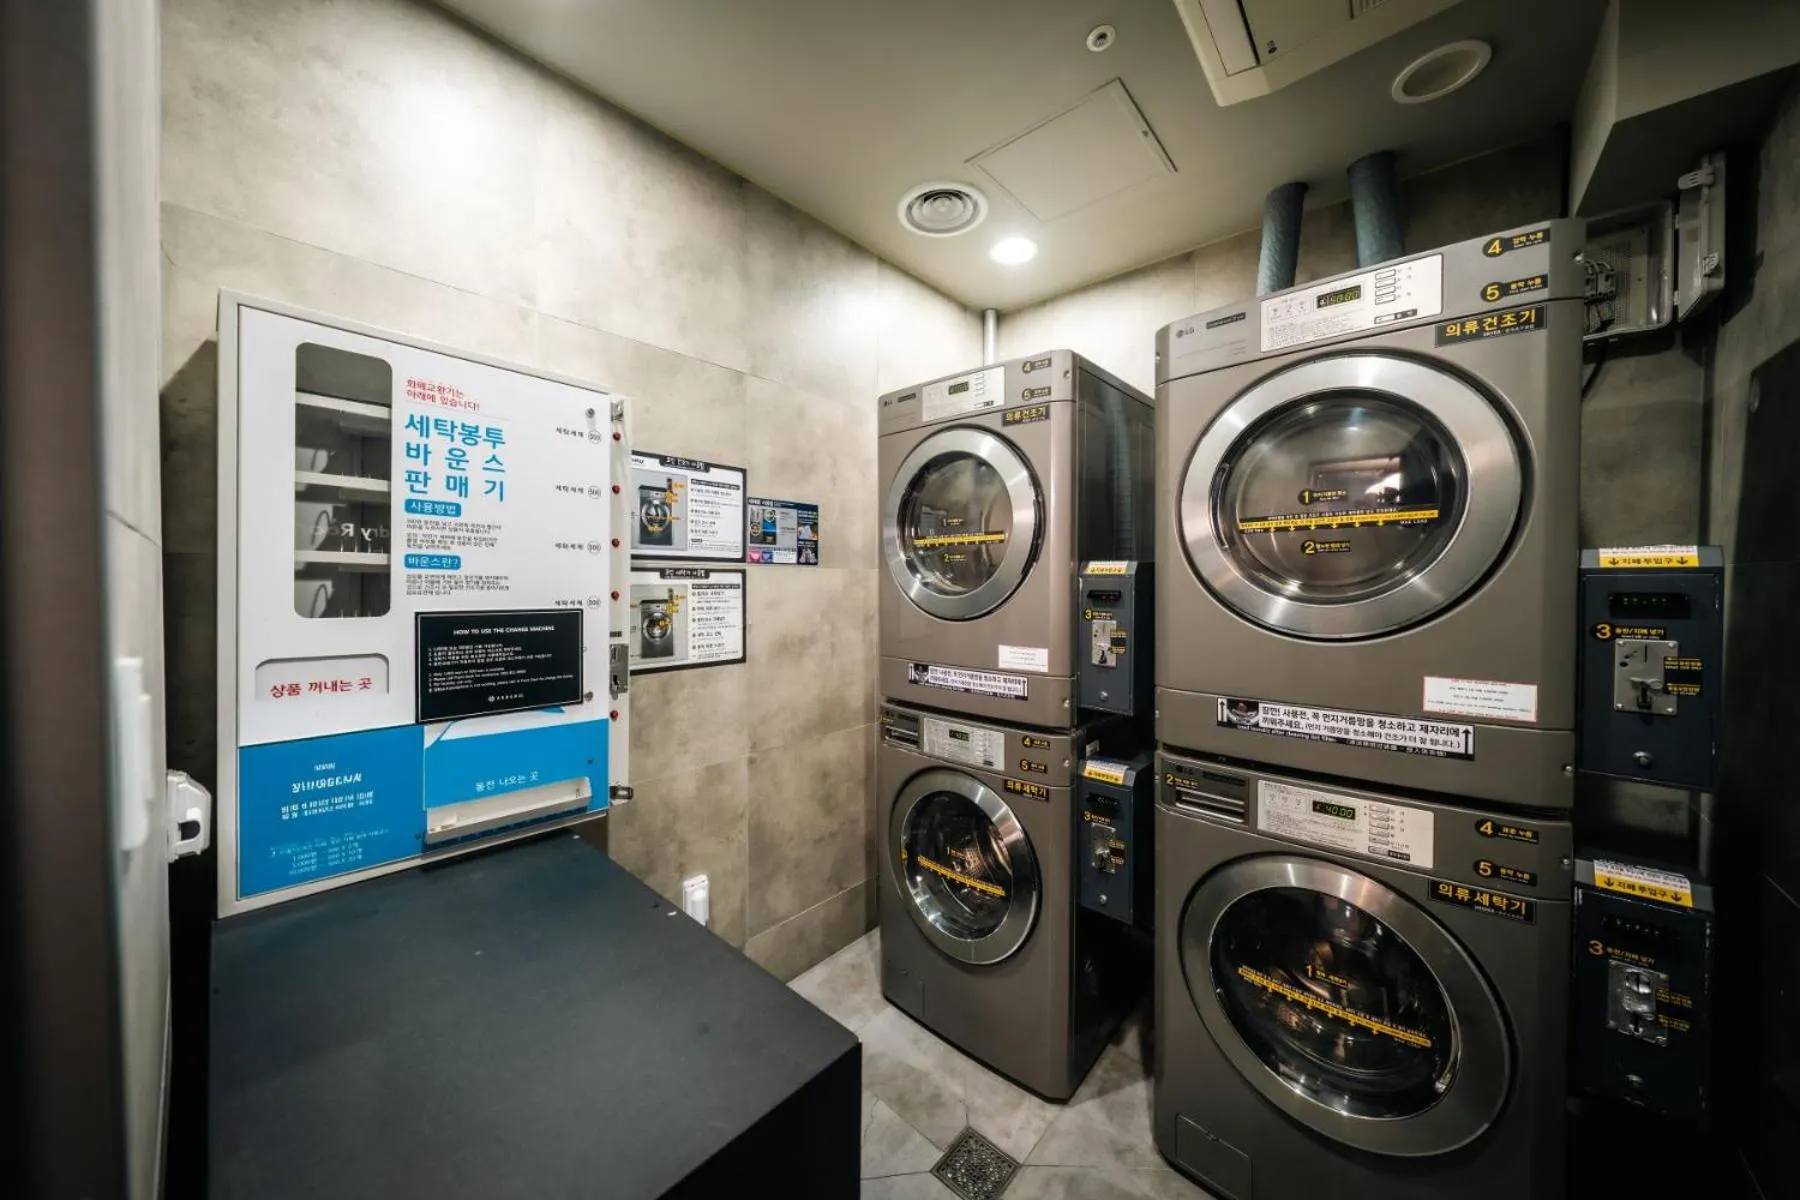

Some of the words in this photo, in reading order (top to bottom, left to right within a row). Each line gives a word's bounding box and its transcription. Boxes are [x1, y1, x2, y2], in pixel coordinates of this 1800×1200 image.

[1488, 240, 1502, 254] 4
[1486, 285, 1499, 301] 5
[1445, 309, 1536, 337] 의류건조기
[1024, 362, 1031, 372] 4
[1024, 390, 1031, 400] 5
[404, 413, 506, 450] 세탁봉투
[1304, 491, 1309, 503] 1
[411, 500, 457, 515] 사용방법
[1304, 541, 1315, 554] 2
[1085, 609, 1091, 619] 3
[1596, 623, 1611, 639] 3
[270, 682, 302, 699] 상품
[308, 678, 354, 694] 꺼내는
[357, 676, 374, 691] 곳
[1322, 712, 1374, 728] 먼지거름망을
[1378, 719, 1416, 732] 청소하고
[1419, 724, 1460, 738] 제자리에
[1024, 737, 1030, 745] 4
[498, 774, 527, 787] 나오는
[528, 770, 540, 784] 곳
[1166, 774, 1173, 785] 2
[1084, 811, 1091, 821] 3
[1480, 821, 1493, 835] 4
[1479, 861, 1492, 876] 5
[1438, 883, 1526, 915] 의류세탁기
[1589, 940, 1604, 955] 3
[1307, 965, 1312, 978] 1
